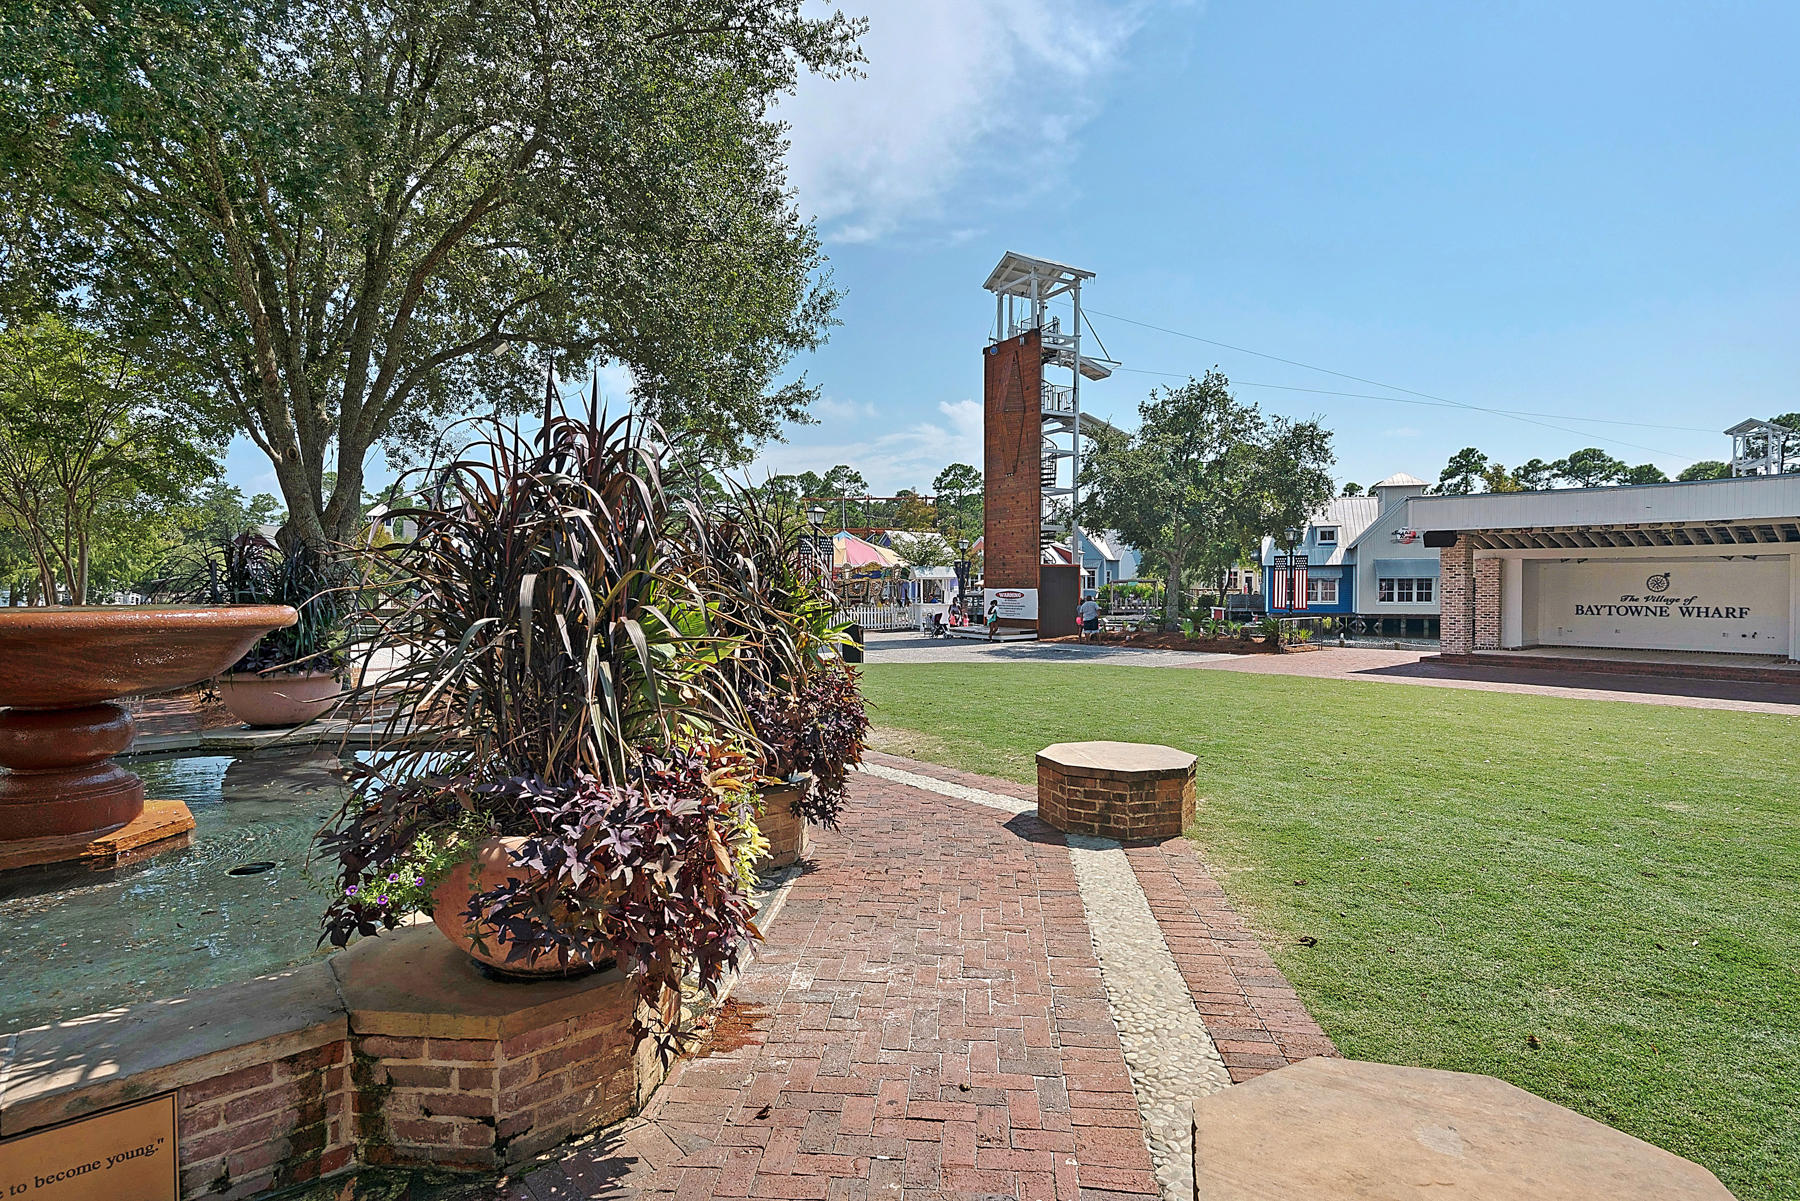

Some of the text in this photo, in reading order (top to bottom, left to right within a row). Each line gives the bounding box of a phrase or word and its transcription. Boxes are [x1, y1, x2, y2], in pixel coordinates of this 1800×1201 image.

[1620, 594, 1698, 605] The Village of
[1575, 604, 1750, 619] BAYTOWNE WHARF
[9, 1137, 165, 1196] to become young."
